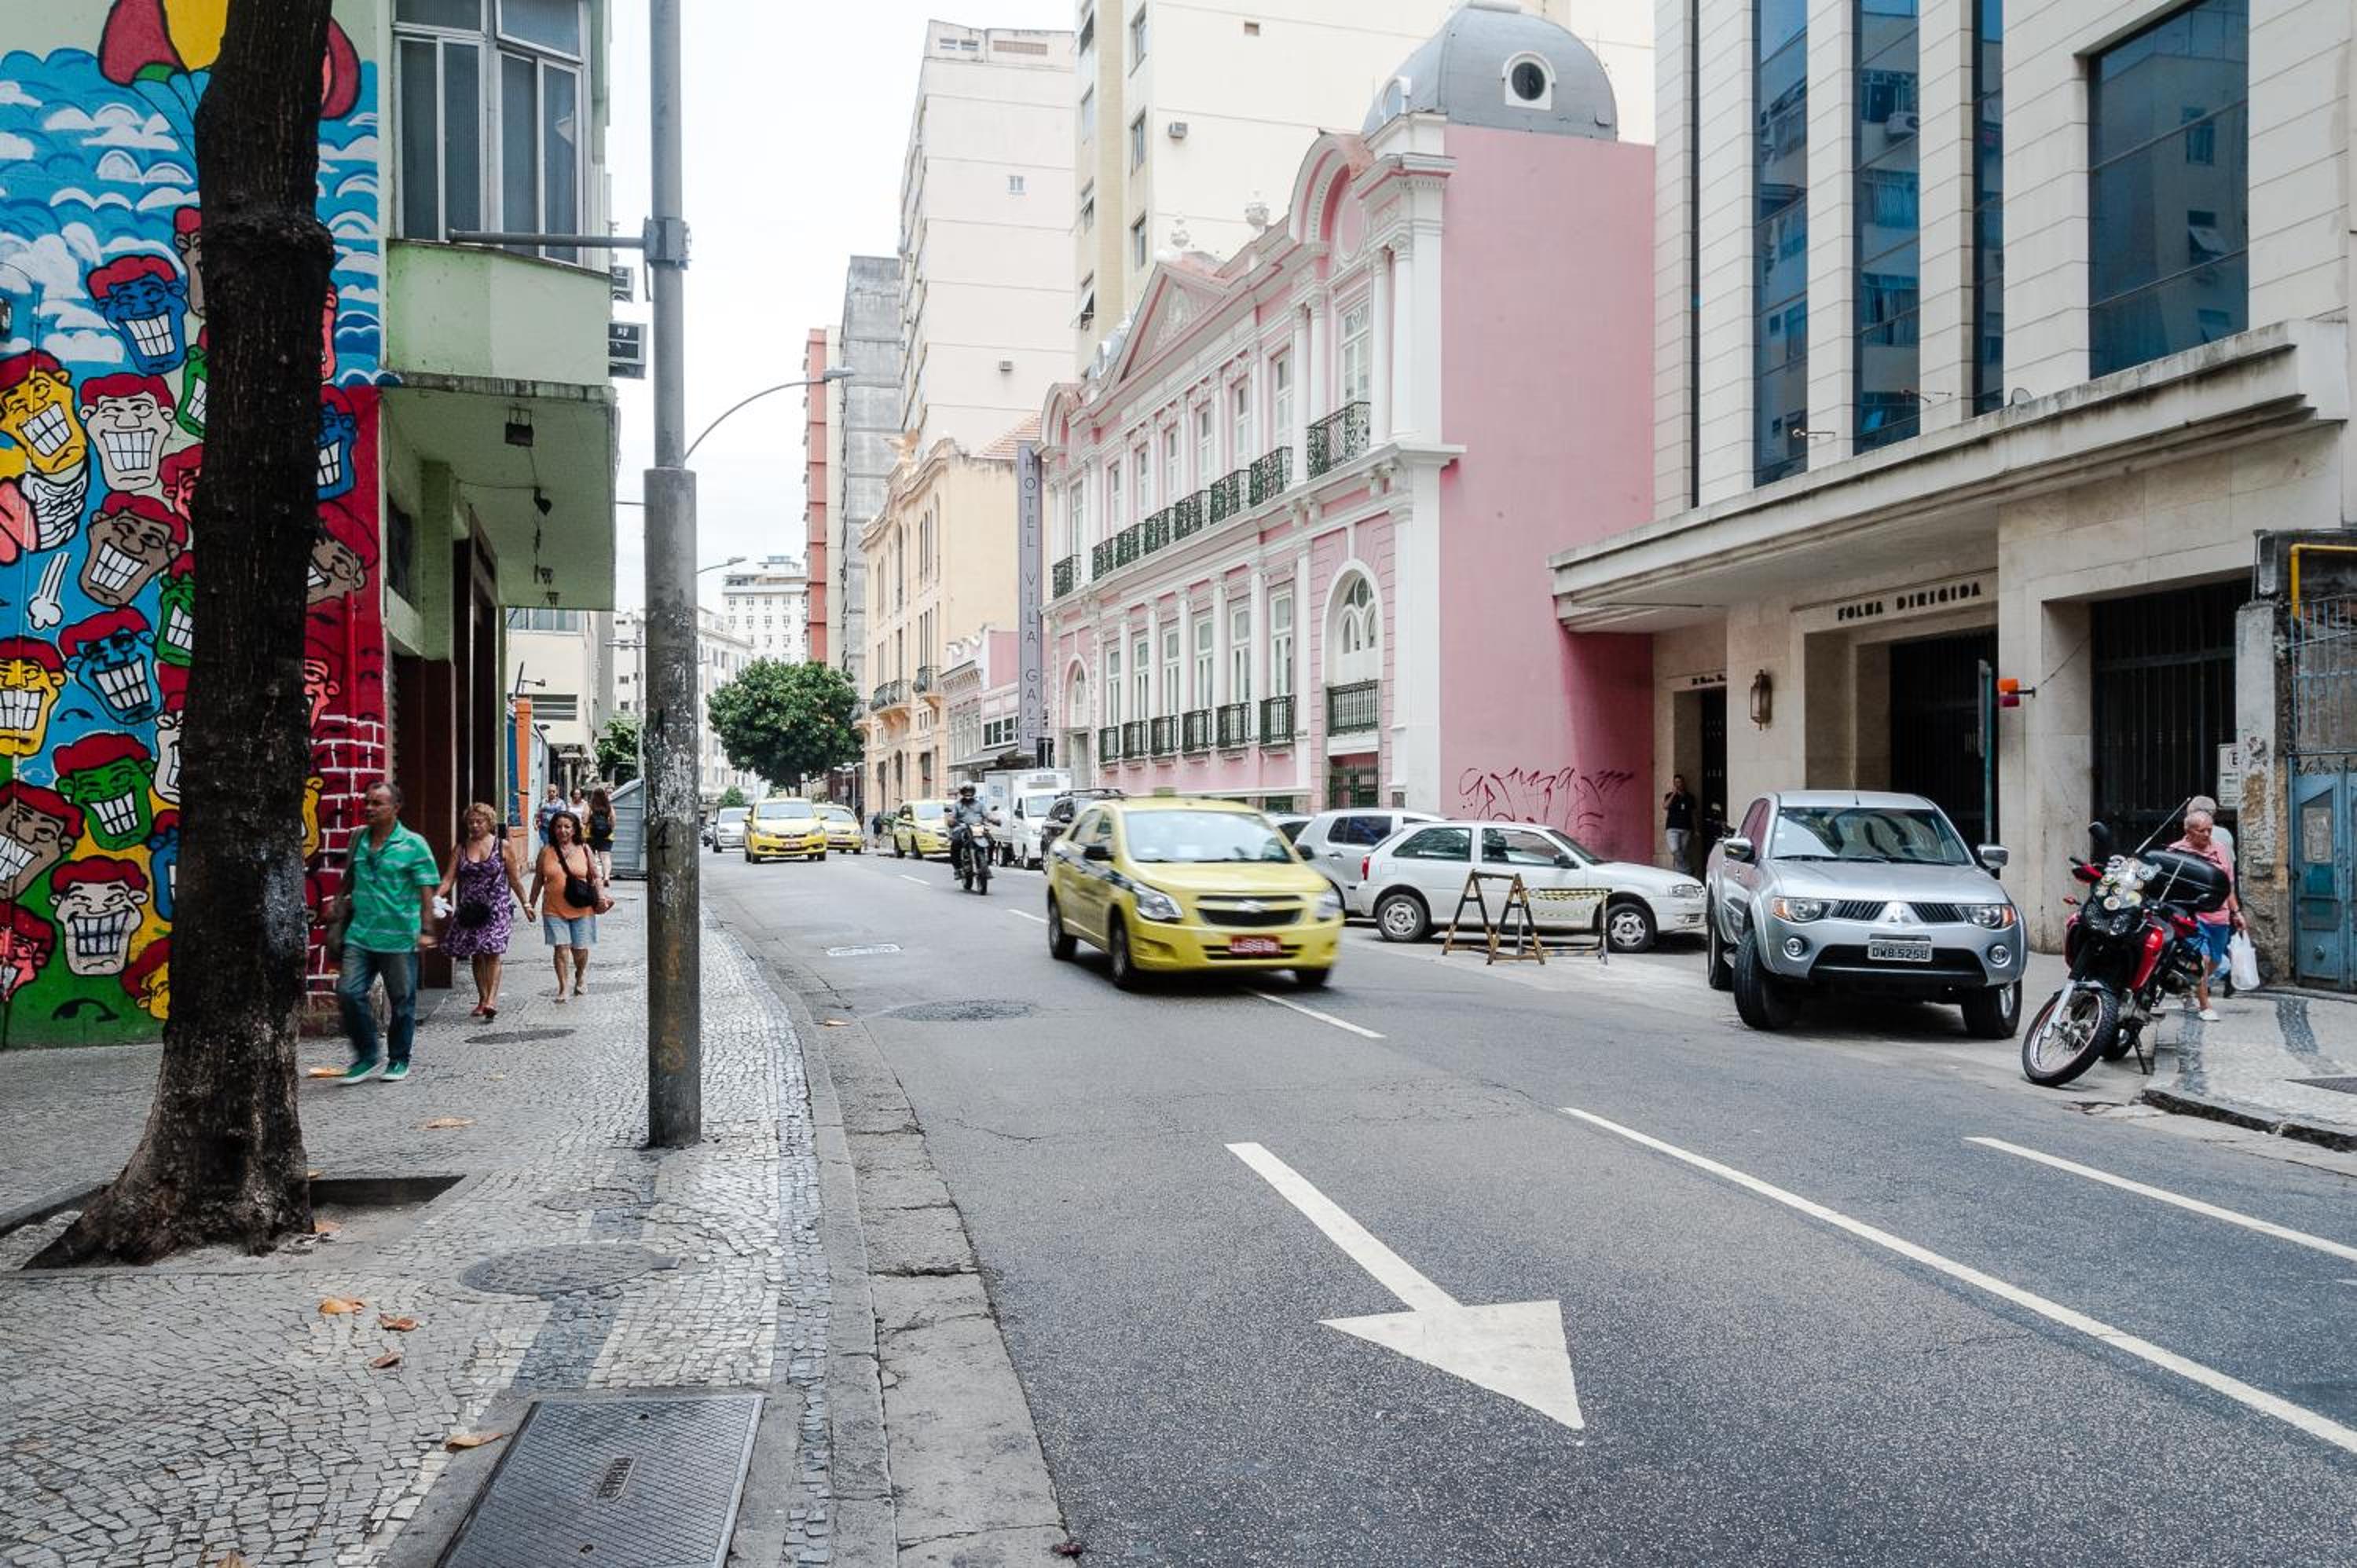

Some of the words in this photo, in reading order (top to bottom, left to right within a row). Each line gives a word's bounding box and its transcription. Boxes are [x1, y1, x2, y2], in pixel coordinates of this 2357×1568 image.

[1024, 457, 1036, 548] HOTEL
[1025, 571, 1037, 643] VILA
[1838, 601, 1883, 621] FOLHA
[1896, 581, 1981, 610] DIRIGIDA
